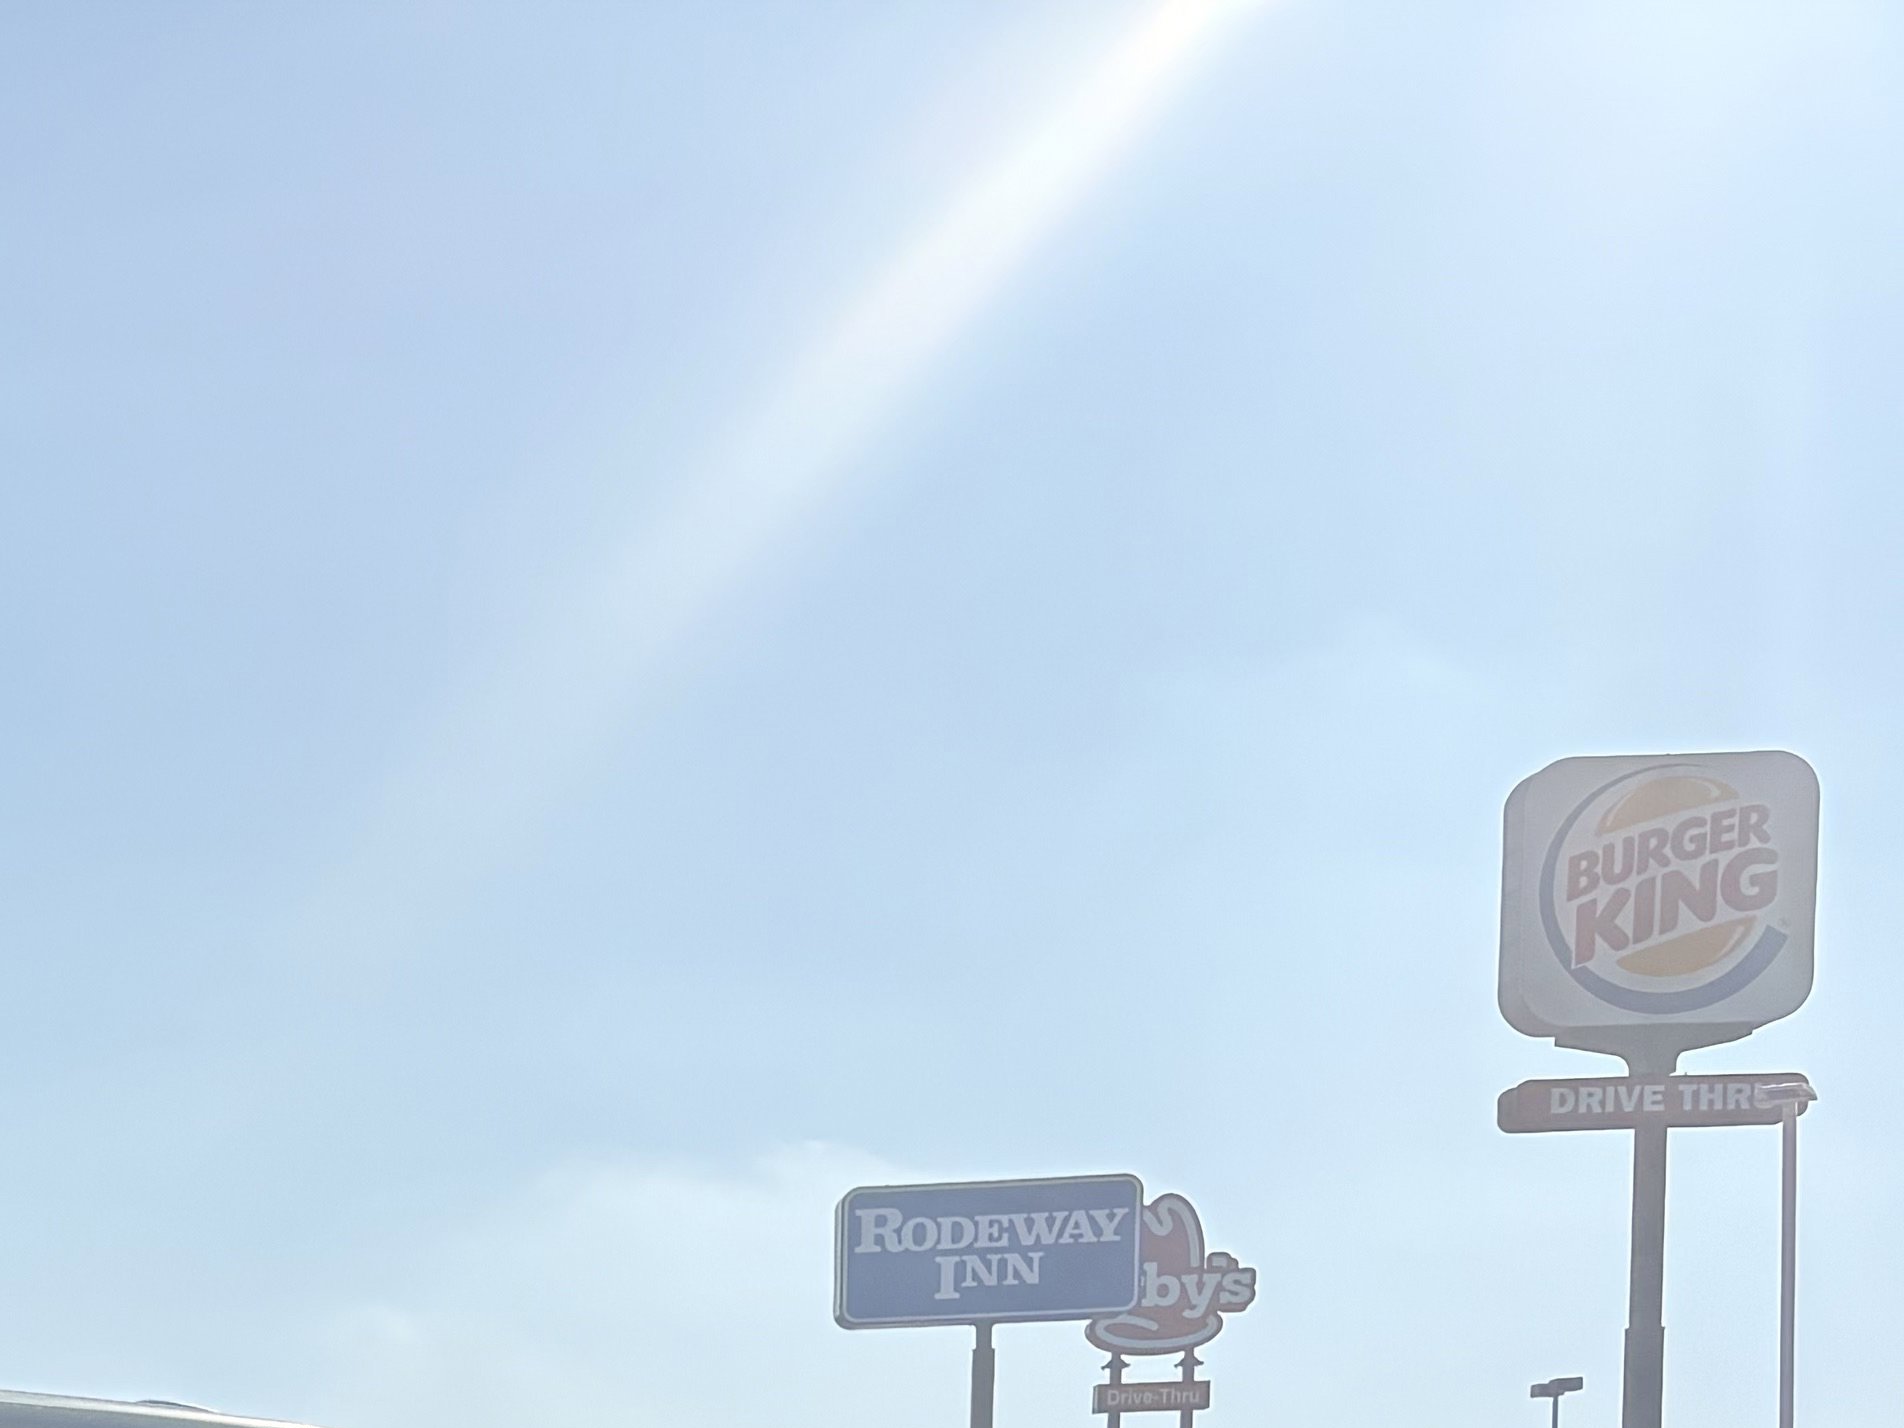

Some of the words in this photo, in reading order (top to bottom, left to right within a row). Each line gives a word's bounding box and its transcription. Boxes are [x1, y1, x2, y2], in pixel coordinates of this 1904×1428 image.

[1566, 803, 1773, 902] BURGER
[1574, 846, 1779, 967] KING
[1550, 1084, 1665, 1114] DRIVE
[854, 1206, 1130, 1254] RODEWAY
[934, 1251, 1044, 1300] INN
[1107, 1387, 1201, 1406] Drive-Thru
